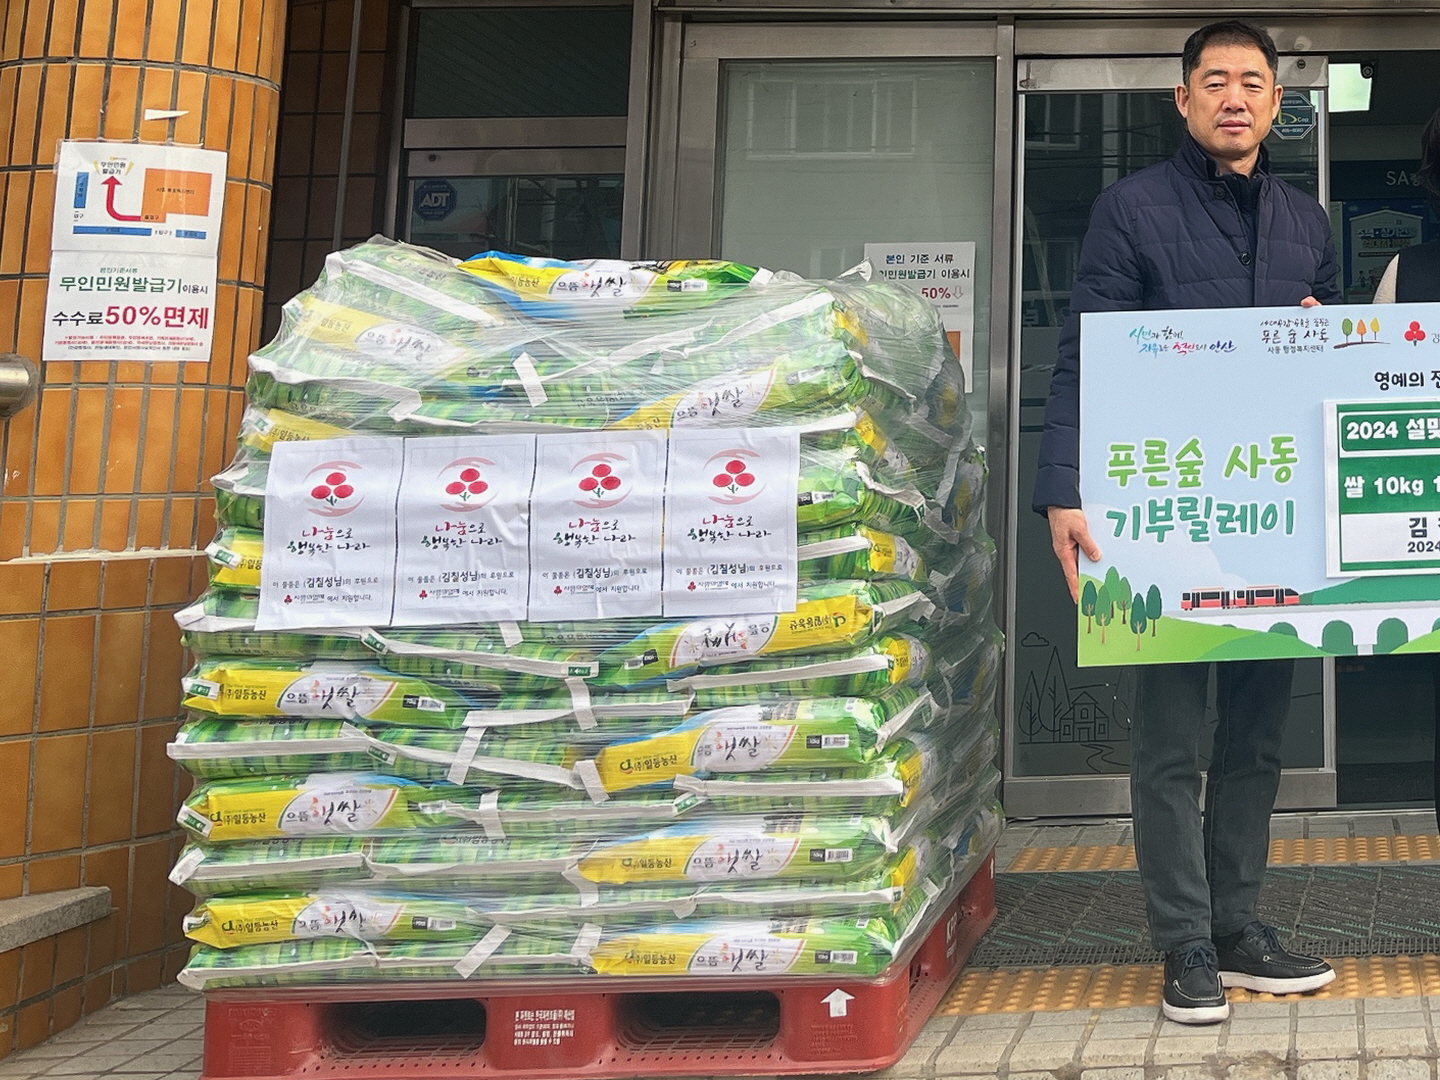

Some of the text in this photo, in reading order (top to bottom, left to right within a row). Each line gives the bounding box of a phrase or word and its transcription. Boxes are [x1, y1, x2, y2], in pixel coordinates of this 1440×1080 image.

[419, 192, 449, 208] ADT
[886, 254, 954, 264] 본인 기준 서류
[941, 268, 970, 279] 이용시
[1261, 329, 1281, 344] 푸른
[1209, 340, 1238, 353] 안산
[1374, 371, 1425, 391] 영예의
[1346, 421, 1399, 440] 2024
[1107, 436, 1298, 488] 푸른숲 사동
[1343, 475, 1365, 498] 쌀
[1374, 476, 1424, 497] 10kg
[1106, 496, 1294, 543] 기부릴레이
[603, 535, 636, 544] 나라
[738, 530, 772, 539] 나라
[337, 542, 370, 551] 나라
[471, 538, 503, 546] 나라
